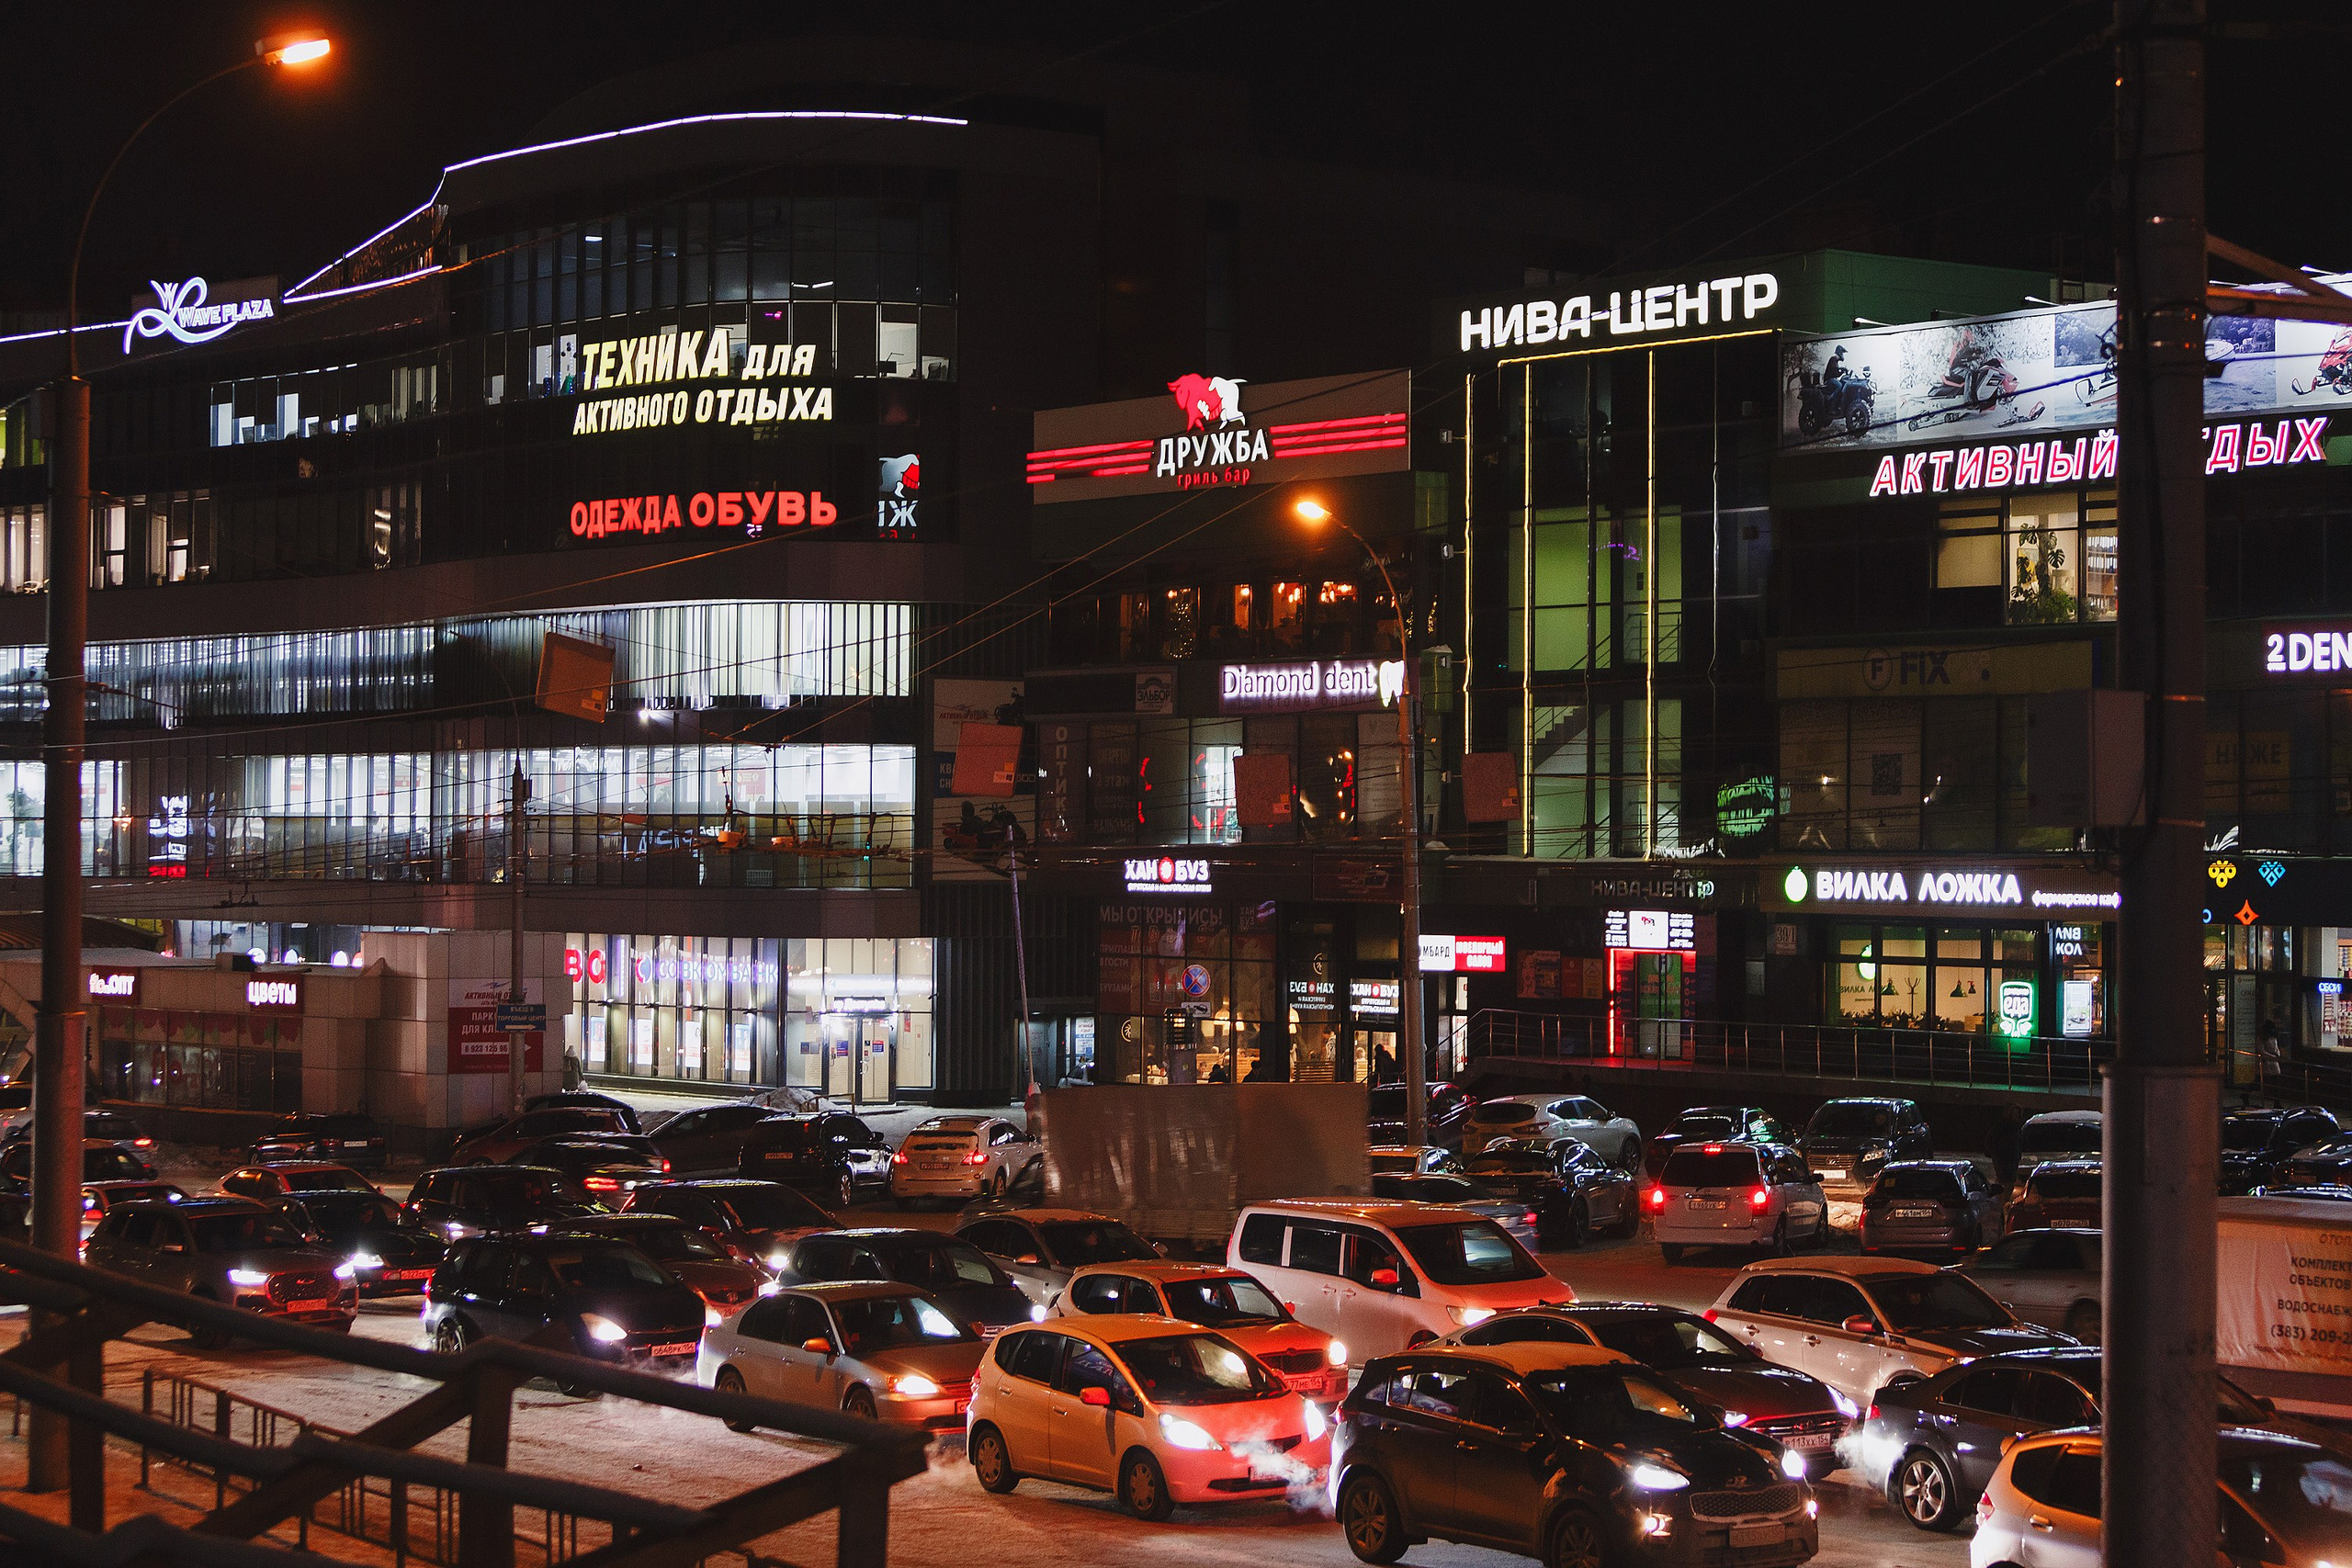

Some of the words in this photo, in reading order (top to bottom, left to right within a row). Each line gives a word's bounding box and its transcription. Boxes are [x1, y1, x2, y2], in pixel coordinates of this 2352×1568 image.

[177, 305, 220, 328] WAVE
[221, 299, 274, 323] PLAZA
[1461, 273, 1778, 351] НИВА-ЦЕНТР
[583, 330, 731, 390] ТЕХНИКА
[573, 390, 689, 435] АКТИВНОГО
[695, 388, 833, 426] ОТДЫХА
[1157, 429, 1269, 478] ДРУЖБА
[1870, 429, 2119, 497] АКТИВНЫЙ
[2202, 416, 2328, 477] ДЫХ
[1178, 471, 1219, 491] гриль
[1225, 467, 1251, 486] бар
[571, 494, 683, 539] ОДЕЖДА
[690, 491, 838, 527] ОБУВЬ
[1223, 665, 1317, 694] Diamond
[1324, 664, 1376, 692] dent
[1125, 860, 1158, 880] ХАН
[1175, 860, 1209, 881] БУЗ
[1815, 871, 1907, 900] ВИЛКА
[1918, 873, 2022, 904] ЛОЖКА
[1100, 905, 1124, 922] МЫ
[461, 1024, 480, 1036] ДЛЯ
[471, 1011, 494, 1021] ПАРК
